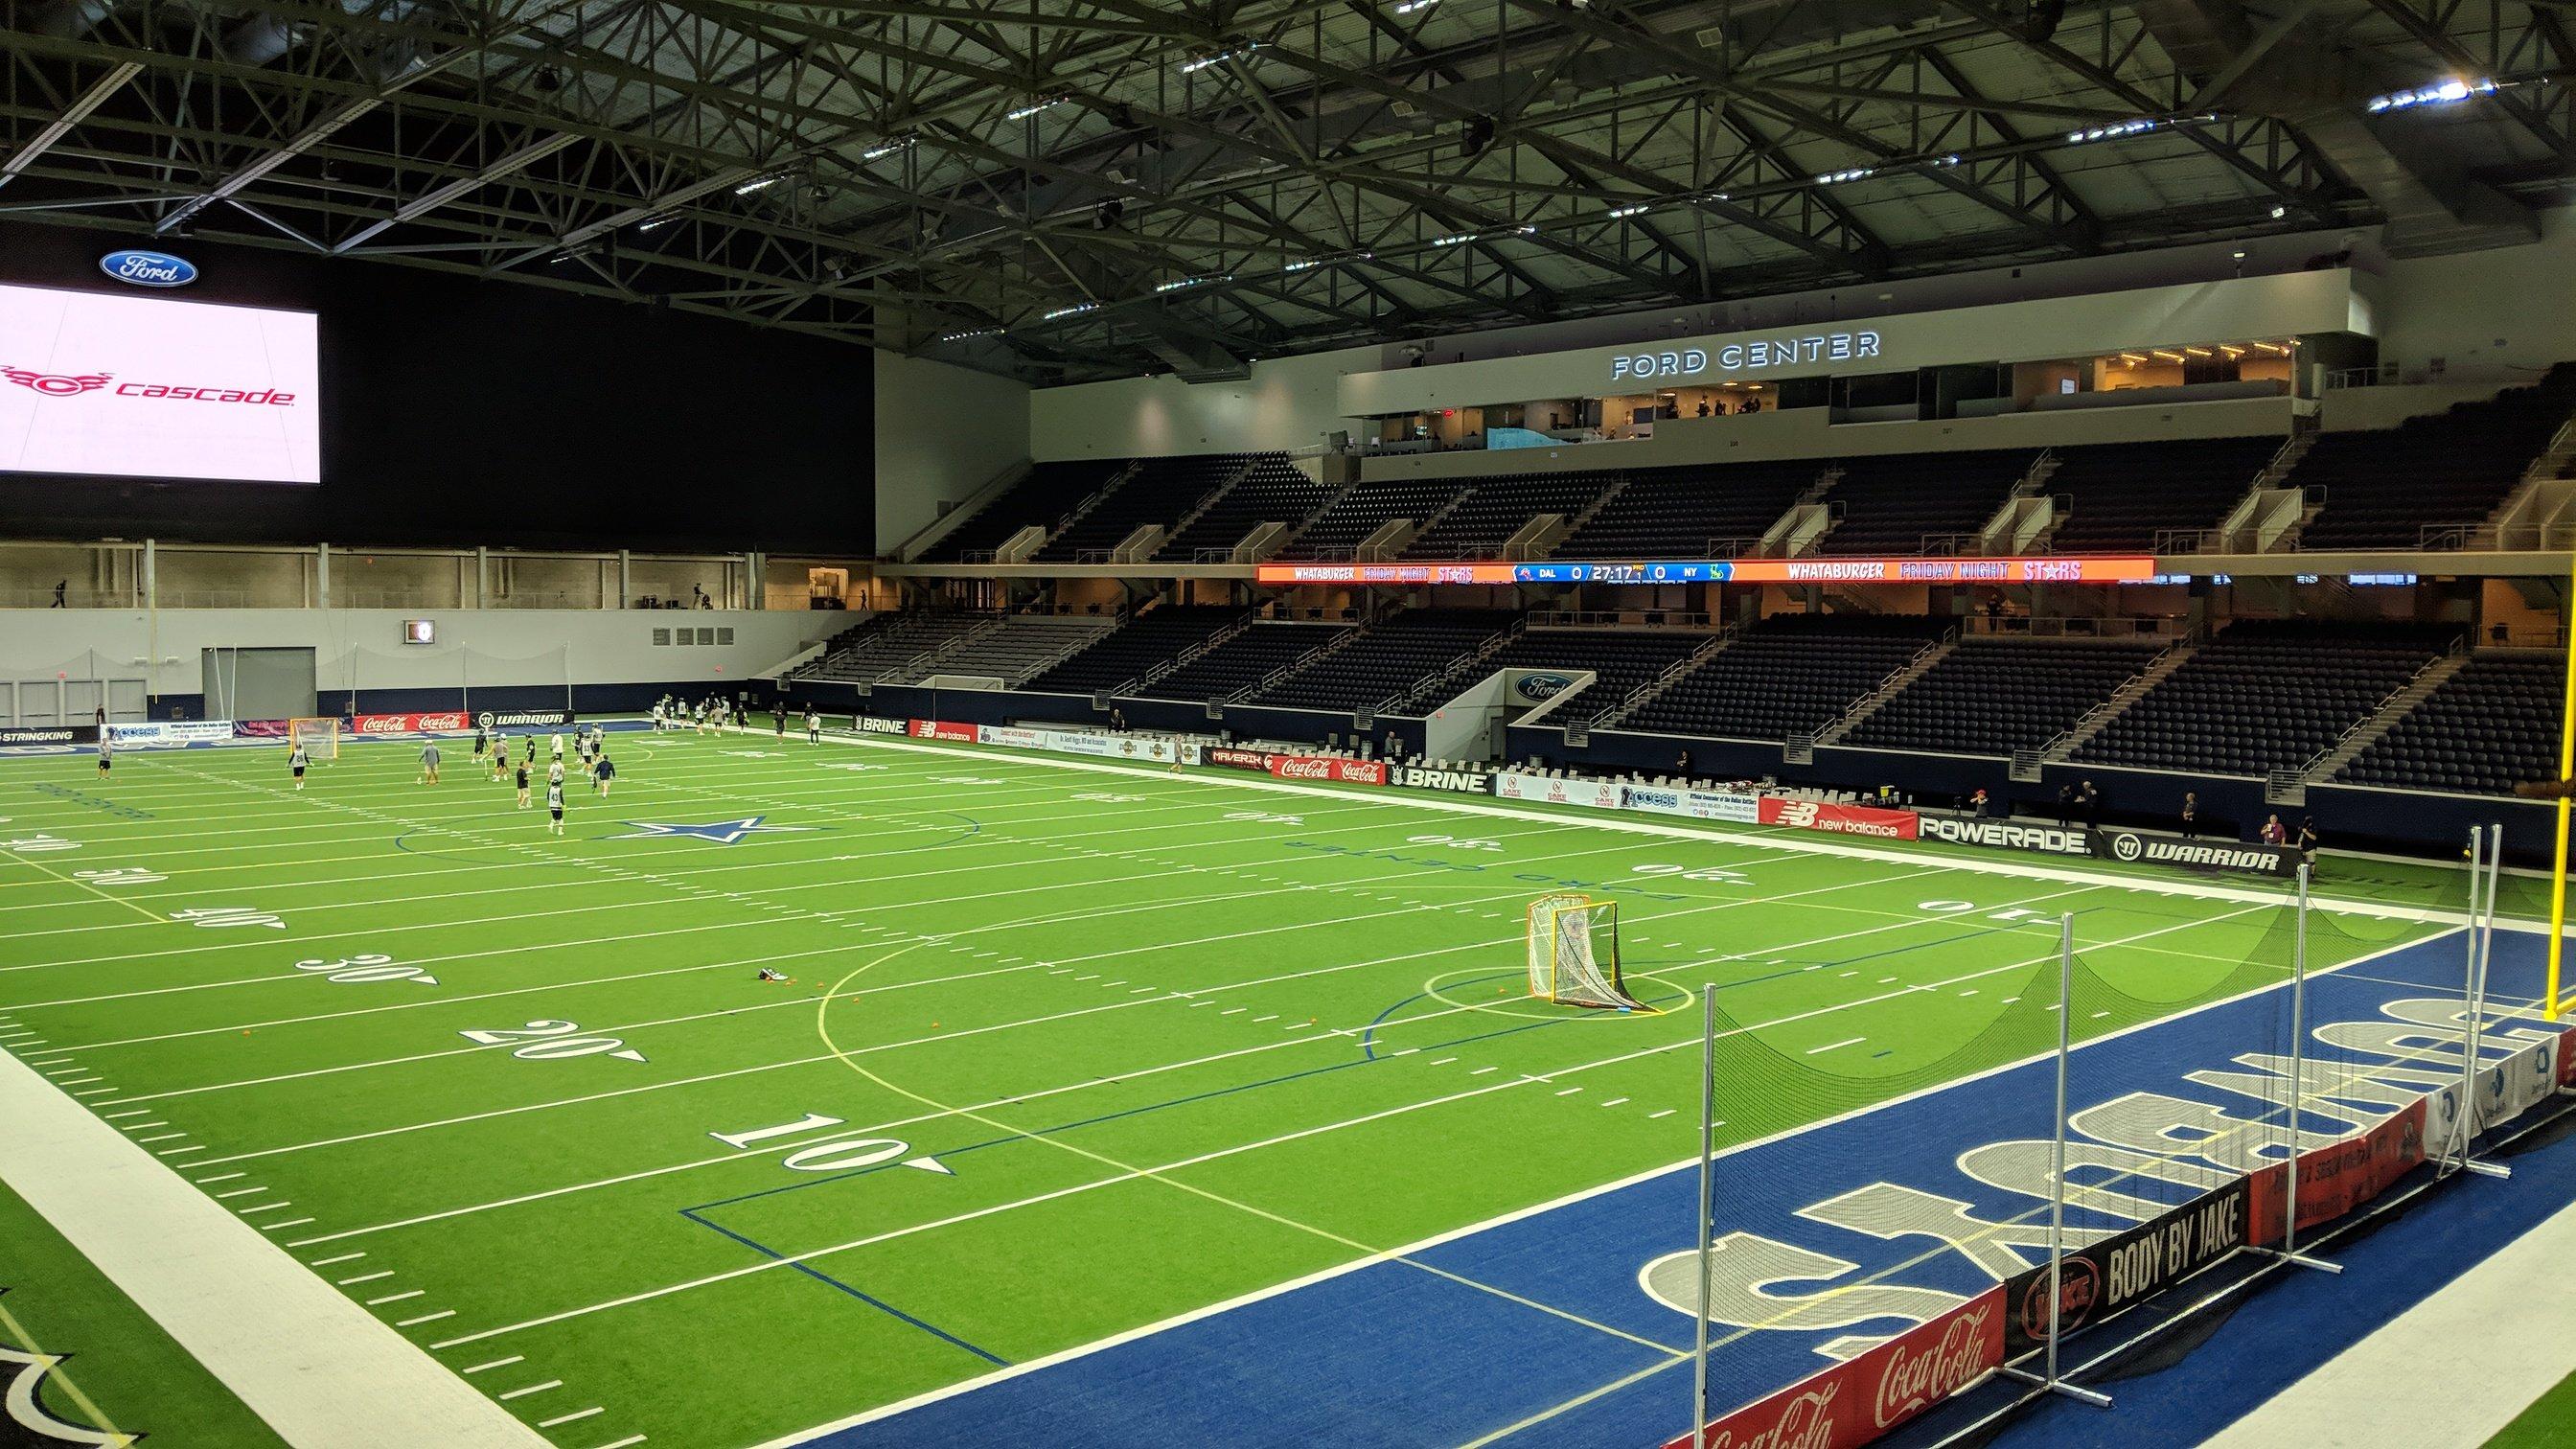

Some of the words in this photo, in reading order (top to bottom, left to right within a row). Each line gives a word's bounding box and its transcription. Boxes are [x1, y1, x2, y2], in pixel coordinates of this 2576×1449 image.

[120, 254, 179, 283] Ford
[1612, 351, 1706, 380] FORD
[1718, 332, 1880, 369] CENTER
[116, 382, 295, 406] cascade
[1295, 567, 1355, 580] WHATABURGER
[1364, 567, 1396, 581] FRIDAY
[1539, 568, 1556, 578] DAL
[1572, 566, 1582, 580] 0
[1593, 566, 1633, 580] 27:17
[1655, 566, 1666, 579] 0
[1684, 567, 1697, 577] NY
[1788, 564, 1885, 580] WHATABURGER
[1899, 564, 1956, 580] FRIDAY
[1960, 563, 2011, 580] NIGHT
[362, 715, 408, 732] Coca-Cola
[418, 713, 463, 730] Coca-Cola
[496, 714, 565, 725] WARRIOR
[862, 718, 906, 734] BRINE
[3, 731, 74, 742] STRINGKING
[948, 731, 971, 742] balance
[1212, 751, 1263, 764] MAVERIK
[1281, 759, 1332, 778] Coca-Cola
[1343, 763, 1380, 783] Coca-Cola
[1406, 769, 1486, 793] BRINE
[1819, 819, 1844, 832] new
[1846, 818, 1898, 837] balance
[1919, 816, 2088, 854] POWERADE
[2146, 842, 2280, 871] WARRIOR
[295, 954, 426, 983] 30
[457, 1019, 625, 1060] 20
[708, 1113, 910, 1172] 10
[2108, 1228, 2165, 1305] BODY
[2168, 1213, 2195, 1277] BY
[2196, 1191, 2241, 1262] JAKE
[1874, 1302, 1992, 1429] Coca-Cola
